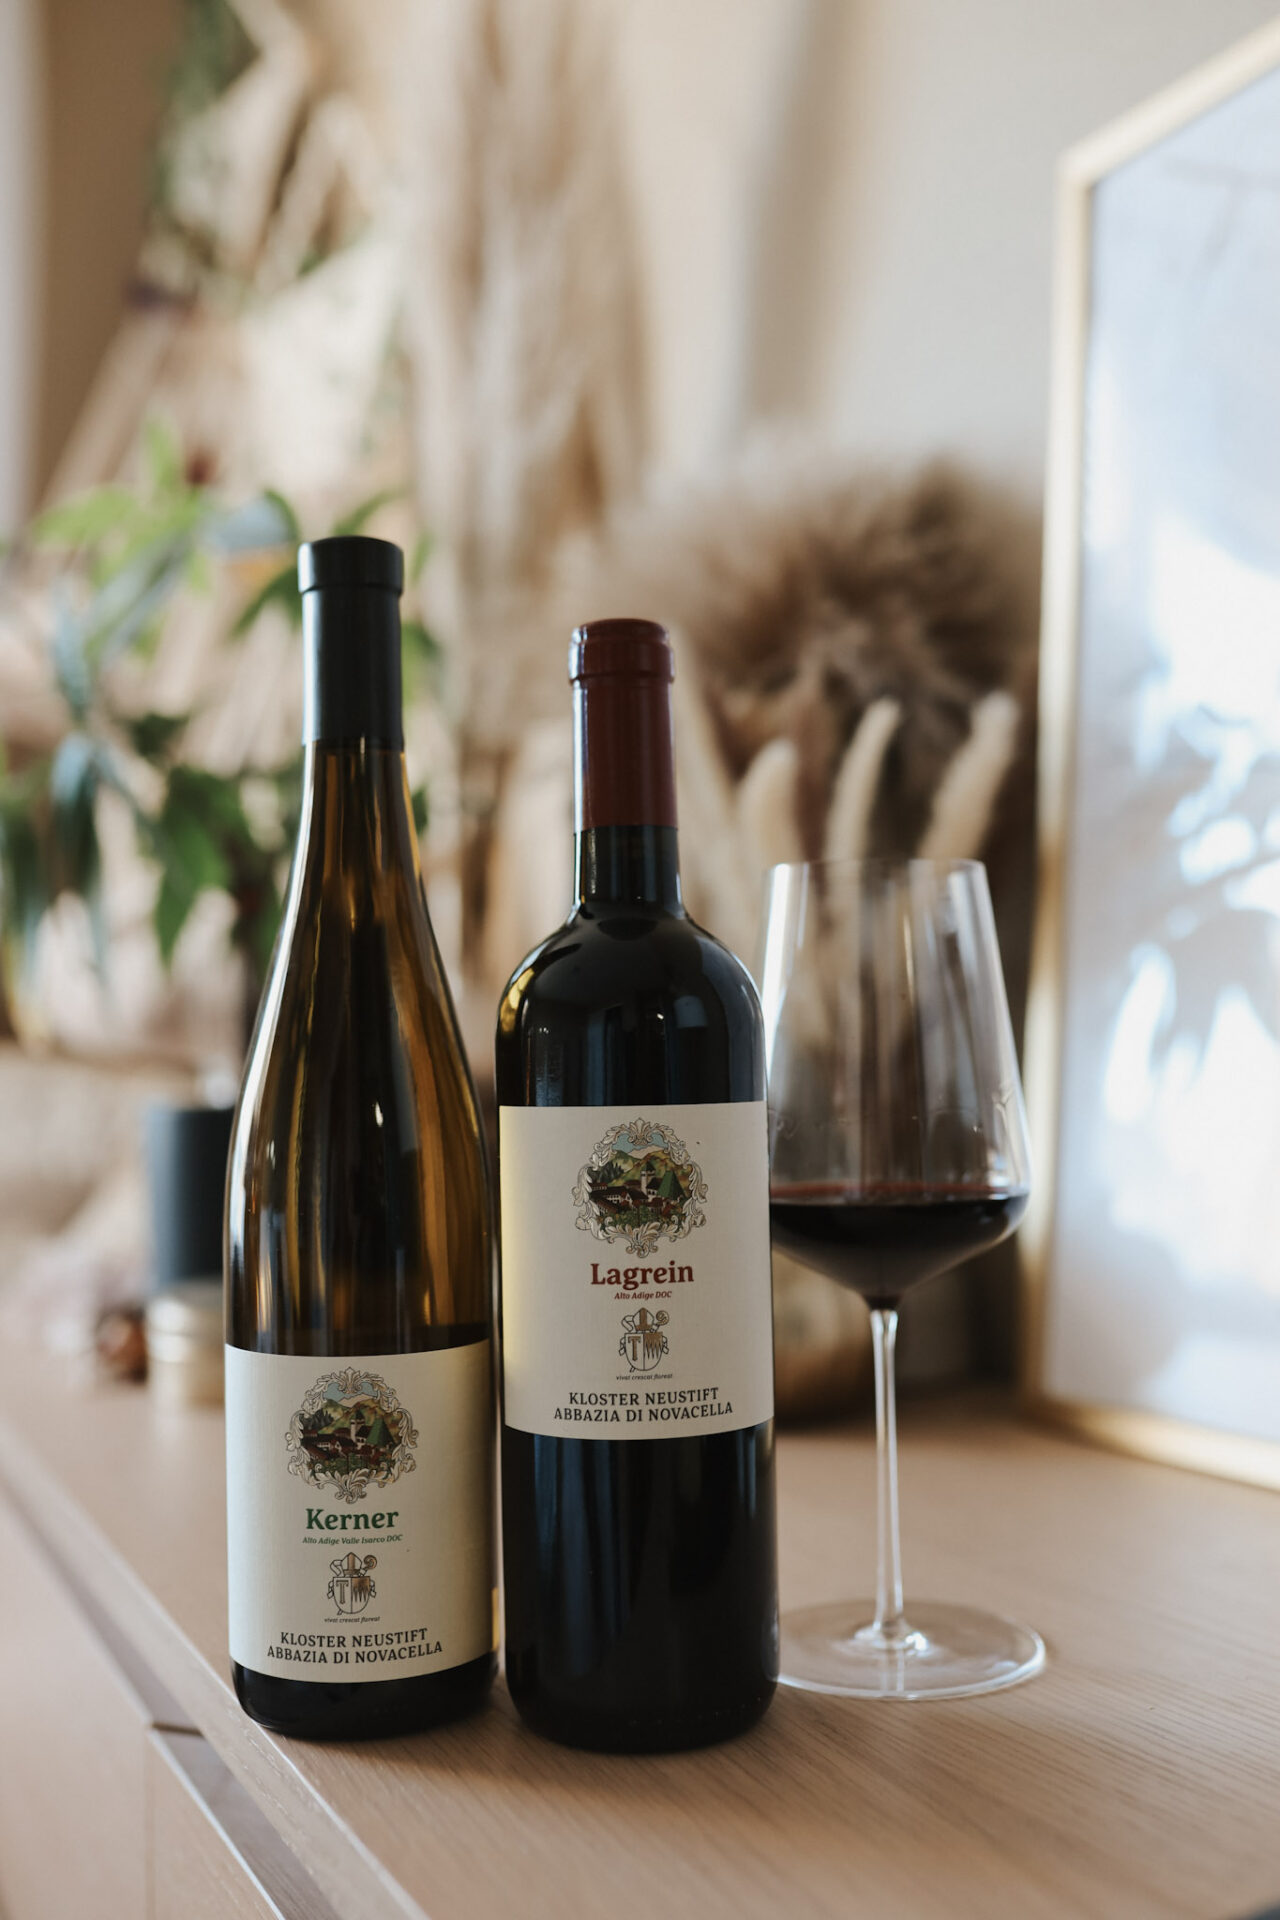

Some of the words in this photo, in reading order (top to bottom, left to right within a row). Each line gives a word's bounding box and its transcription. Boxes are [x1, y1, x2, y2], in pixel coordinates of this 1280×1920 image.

[590, 1260, 694, 1290] Lagrein
[614, 1292, 630, 1300] Alto
[632, 1292, 654, 1300] Adige
[569, 1392, 640, 1406] KLOSTER
[645, 1387, 719, 1405] NEUSTIFT
[554, 1408, 620, 1422] ABBAZIA
[626, 1409, 642, 1422] DI
[649, 1402, 733, 1421] NOVACELLA
[306, 1508, 399, 1530] Kerner
[318, 1537, 340, 1545] Adige
[281, 1632, 346, 1648] KLOSTER
[352, 1628, 428, 1647] NEUSTIFT
[267, 1646, 328, 1664] ABBAZIA
[333, 1651, 349, 1664] DI
[355, 1641, 443, 1663] NOVACELLA
